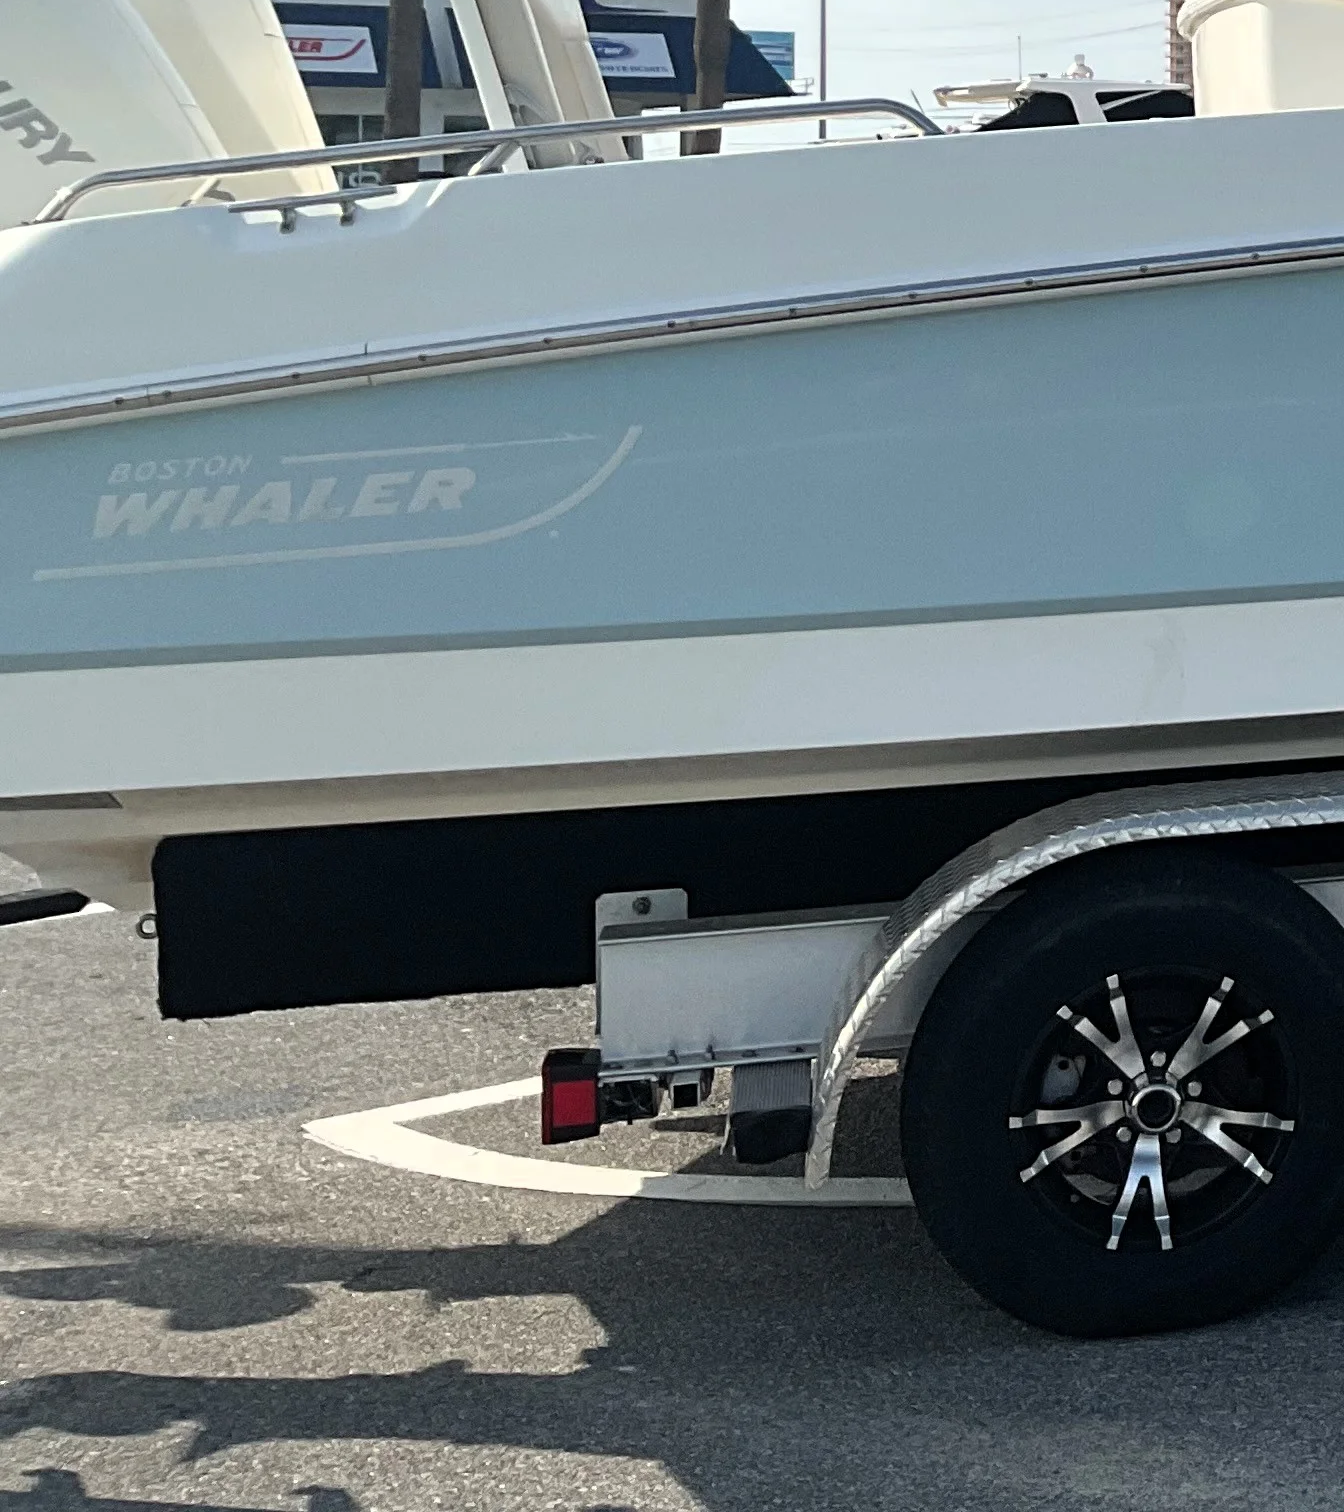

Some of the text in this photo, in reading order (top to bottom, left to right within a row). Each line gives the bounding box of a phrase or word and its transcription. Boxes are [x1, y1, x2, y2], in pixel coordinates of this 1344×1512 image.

[288, 39, 323, 53] LER
[107, 454, 253, 485] BOSTON
[93, 466, 477, 539] WHALER
